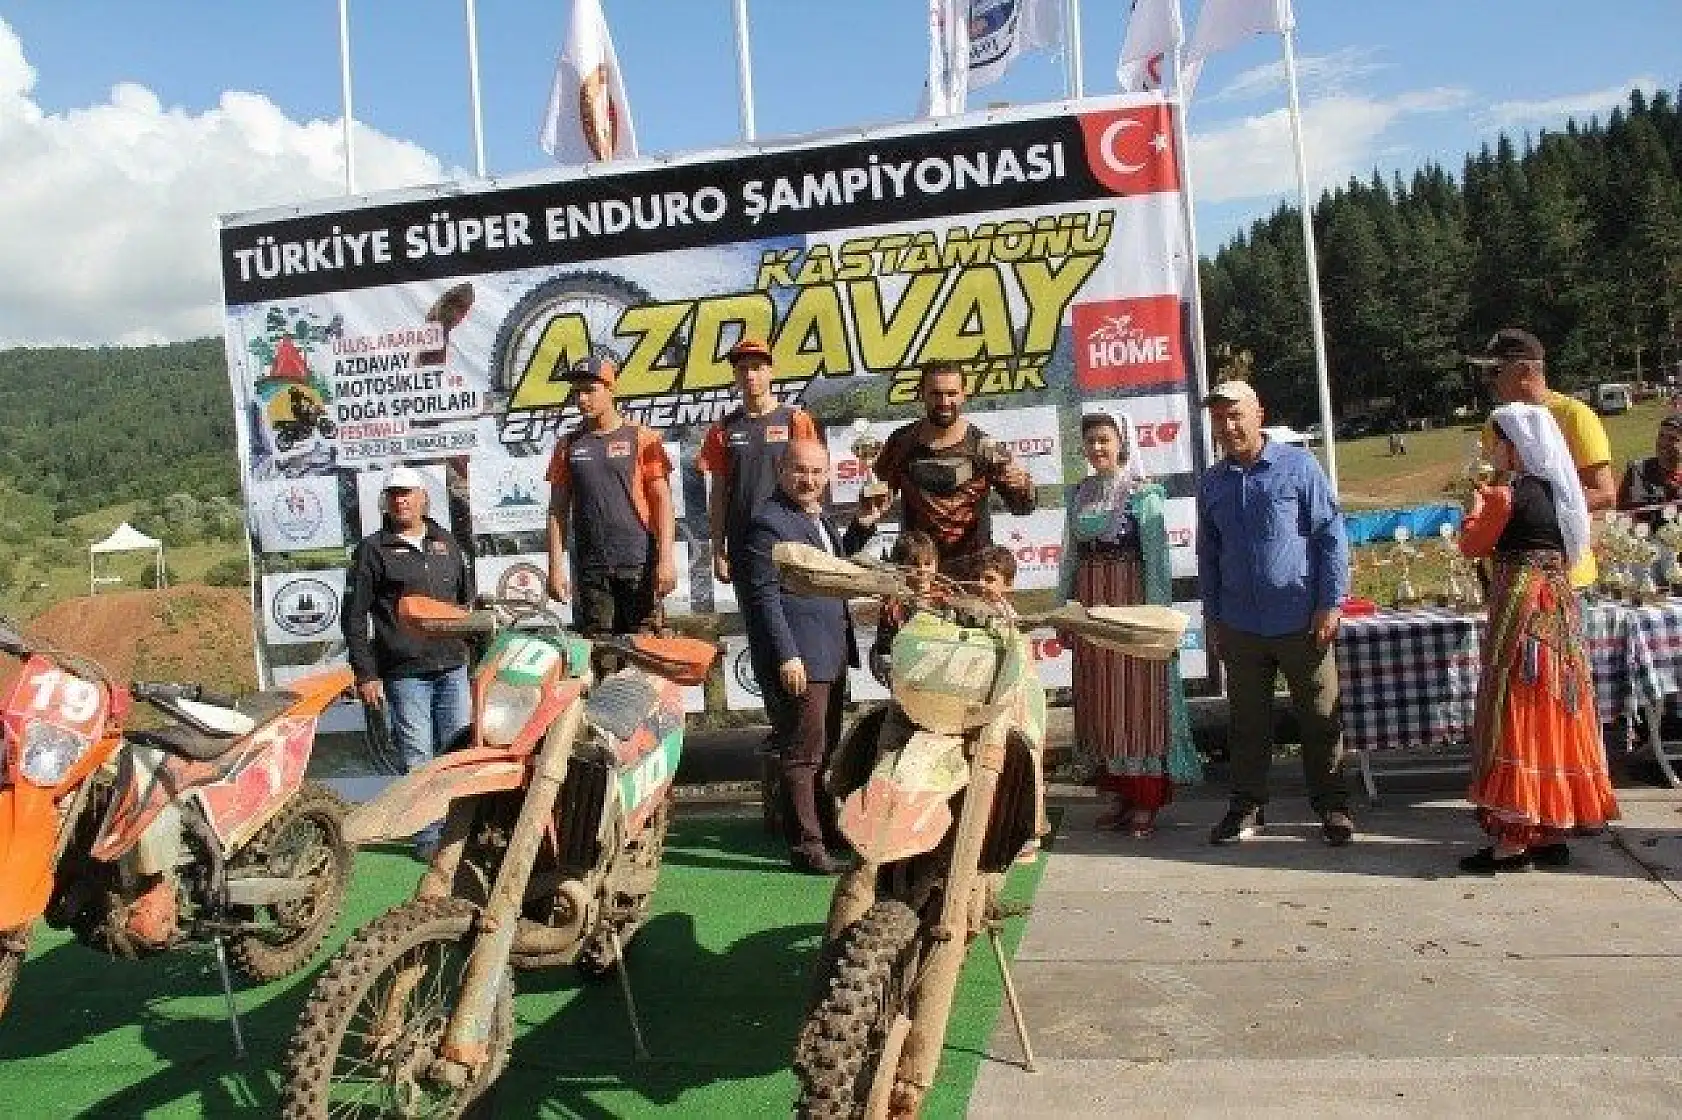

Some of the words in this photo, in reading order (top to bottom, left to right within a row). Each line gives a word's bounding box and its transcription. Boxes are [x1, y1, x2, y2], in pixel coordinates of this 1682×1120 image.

[234, 225, 392, 281] TÜRKİYE
[405, 211, 533, 258] SÜPER
[546, 187, 726, 242] ENDURO
[744, 141, 1065, 223] ŞAMPİYONASI
[757, 209, 1116, 290] KASTAMONU
[333, 329, 439, 355] ULUSLARARASI
[508, 252, 1104, 413] AZDAVAY
[1089, 335, 1172, 369] HOME
[335, 352, 410, 377] AZDAVAY
[335, 371, 444, 398] MOTOSİKLET
[337, 399, 386, 423] DOĞA
[391, 391, 476, 416] SPORLARI
[498, 638, 560, 677] 10
[903, 641, 996, 690] 70
[29, 669, 100, 721] 19
